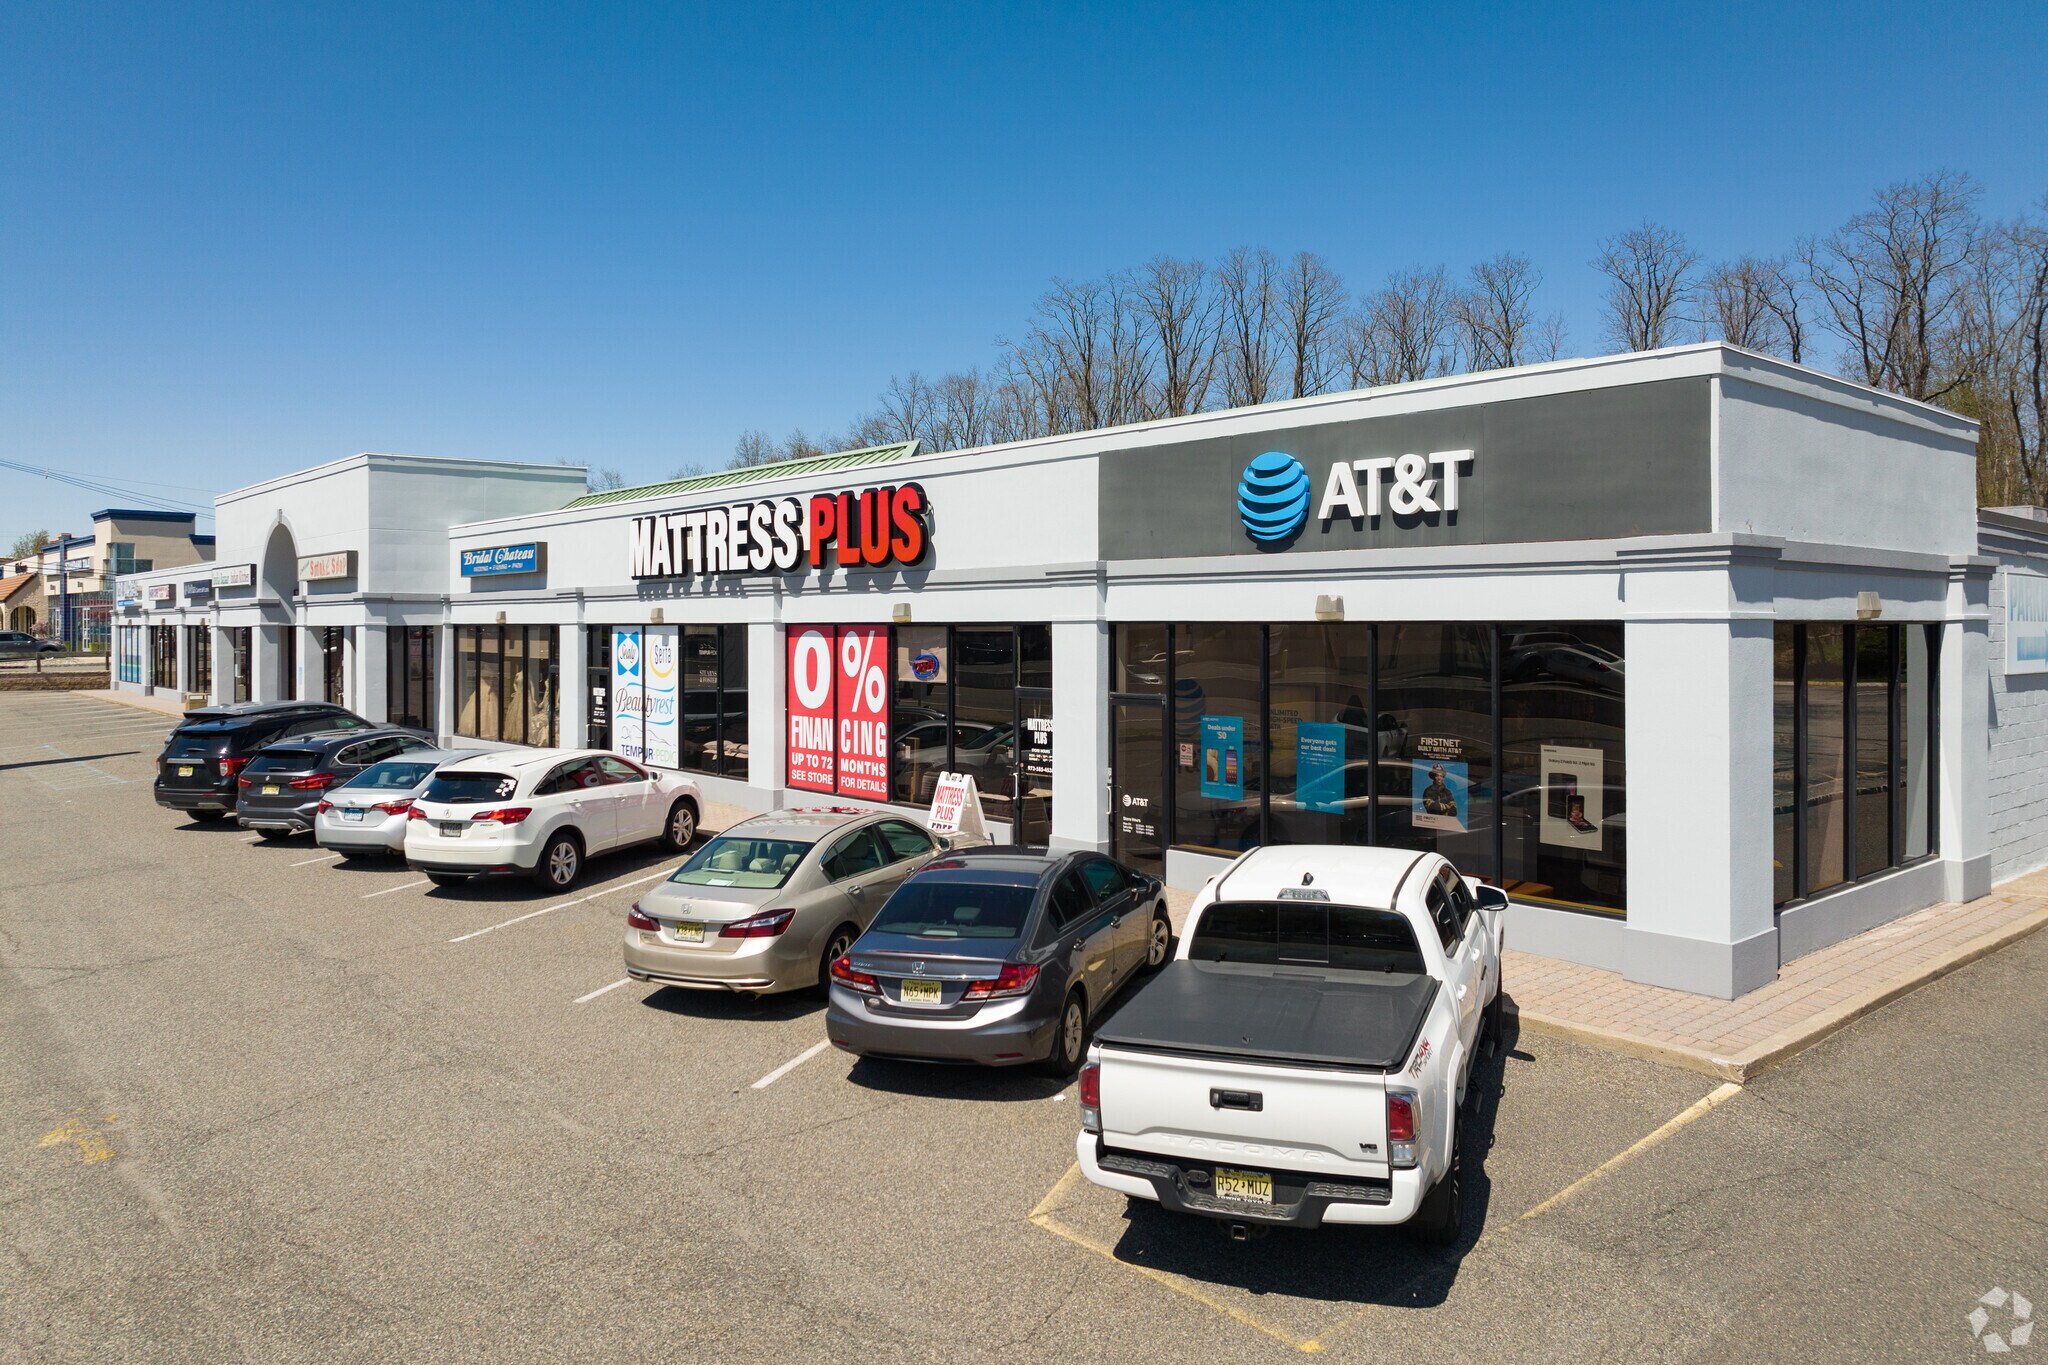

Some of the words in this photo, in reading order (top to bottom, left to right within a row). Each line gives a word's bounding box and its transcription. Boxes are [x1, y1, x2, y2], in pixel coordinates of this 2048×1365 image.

[1318, 449, 1474, 519] AT&T
[630, 499, 801, 577] MATTRESS
[810, 484, 926, 566] PLUS
[463, 549, 493, 565] Bridal
[495, 547, 534, 564] Chateau
[619, 643, 637, 663] Sealy
[794, 630, 831, 709] 0
[842, 630, 885, 713] %
[616, 687, 675, 718] Beautyrest
[792, 715, 833, 751] FINAN
[841, 718, 886, 757] CING
[1034, 731, 1048, 745] PLUS
[1300, 737, 1325, 745] Everyone
[1420, 737, 1461, 748] FIRSTNET
[1433, 746, 1447, 754] WITH
[792, 752, 803, 766] UP
[806, 754, 819, 768] TO
[821, 755, 833, 770] 72
[841, 759, 886, 777] MONTHS
[792, 769, 806, 781] SEE
[808, 771, 833, 785] STORE
[841, 776, 856, 789] FOR
[857, 778, 887, 793] DETAILS
[935, 785, 965, 806] MATTRESS
[1132, 797, 1149, 807] AT&T
[935, 805, 955, 821] PLUS
[1160, 1133, 1326, 1163] TACOMA
[1359, 1142, 1378, 1153] V6
